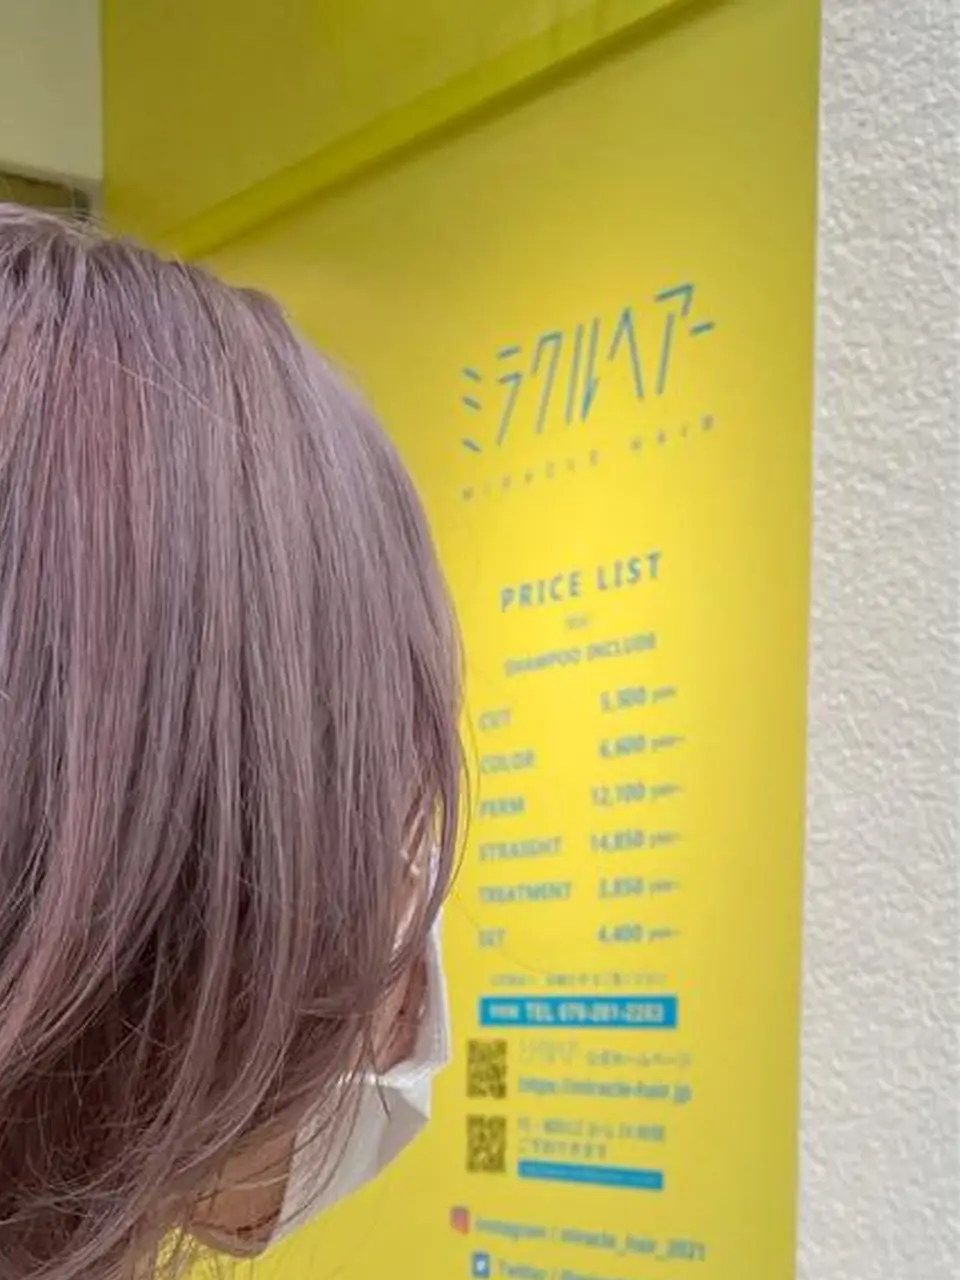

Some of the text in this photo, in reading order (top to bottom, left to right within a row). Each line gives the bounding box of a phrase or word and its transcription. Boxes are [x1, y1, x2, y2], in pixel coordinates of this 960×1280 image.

[500, 552, 662, 612] PRICE LIST
[481, 750, 535, 774] COLOR
[479, 837, 561, 861] STRAIGHT
[479, 881, 572, 903] TREATMENT
